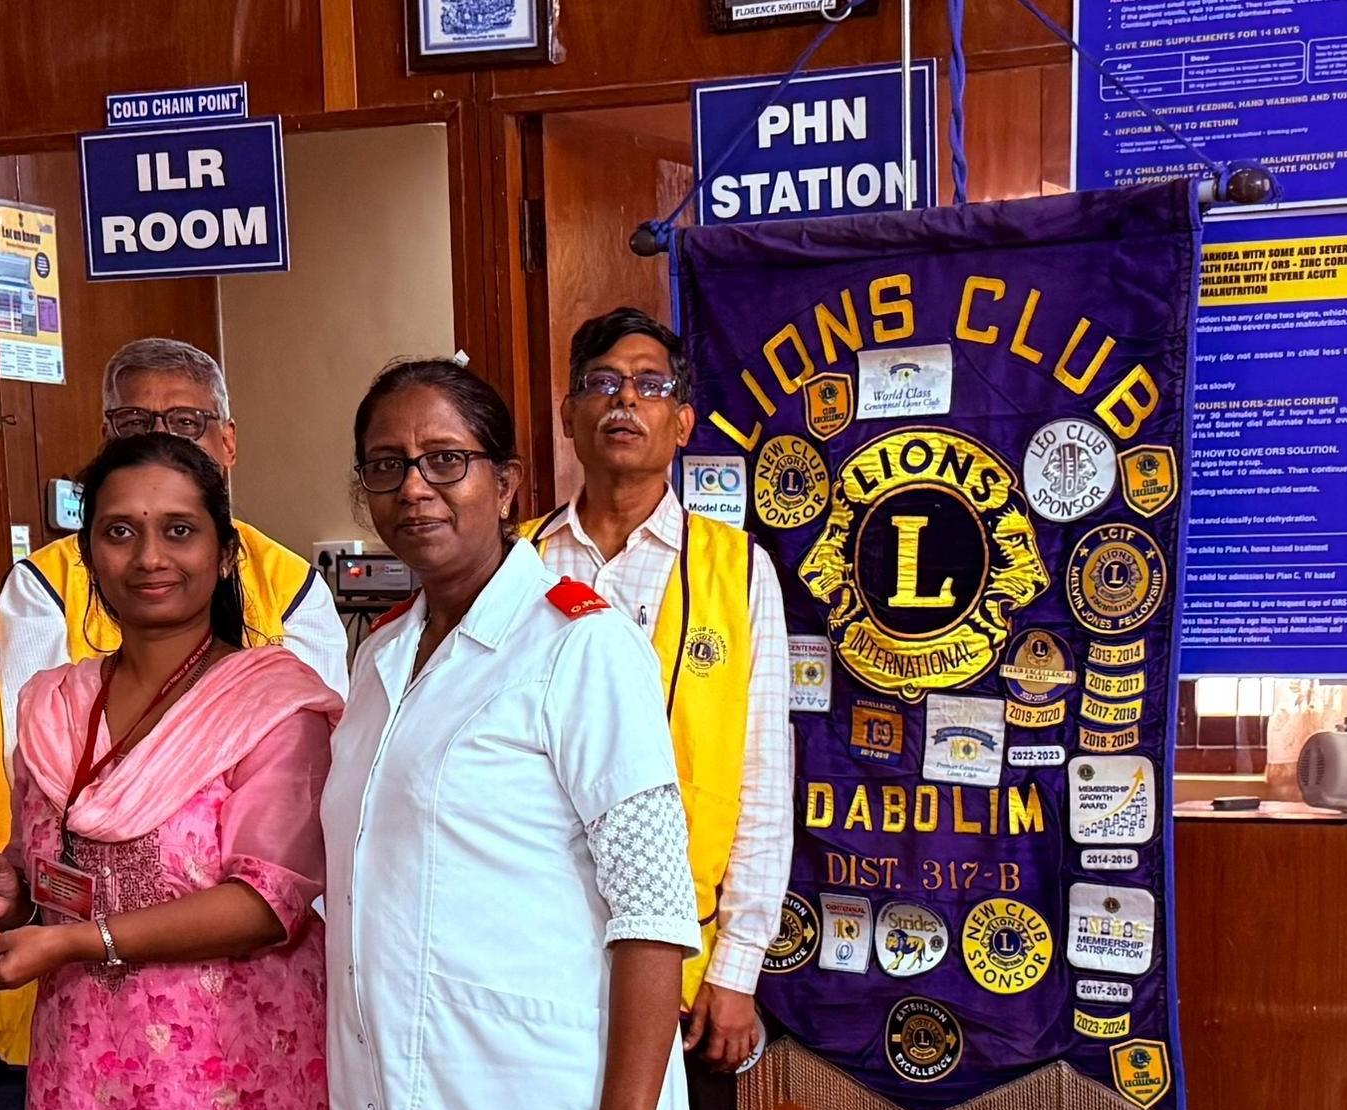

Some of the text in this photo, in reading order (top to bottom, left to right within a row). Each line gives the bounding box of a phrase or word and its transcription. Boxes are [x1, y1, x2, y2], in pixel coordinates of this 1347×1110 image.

[735, 6, 776, 16] FLORENCE
[1115, 41, 1137, 51] GIVE
[1141, 38, 1162, 48] ZINC
[1166, 32, 1235, 46] SUPPLEMENTS
[1238, 30, 1257, 38] FOR
[1274, 26, 1299, 36] DAYS
[113, 92, 239, 118] COLD CHAIN POINT
[757, 97, 867, 149] PHN
[136, 148, 225, 192] ILR
[711, 160, 918, 220] STATION
[102, 206, 268, 254] ROOM
[1242, 250, 1265, 259] WITH
[1268, 247, 1294, 258] SOME
[1297, 246, 1316, 256] AND
[1224, 261, 1263, 272] FACILITY
[1272, 258, 1290, 269] ORS
[1300, 256, 1321, 268] ZINC
[1270, 269, 1337, 281] SEVERE ACUTE
[1200, 285, 1268, 297] MALNUTRITION
[709, 273, 1159, 452] LIONS CLUB
[873, 388, 931, 401] World Class
[1031, 424, 1106, 459] LEO CLUB
[758, 440, 826, 483] NEW CLUB
[851, 437, 1002, 506] LIONS
[689, 502, 741, 513] Model Club
[757, 489, 826, 525] SPONSOR
[1033, 485, 1106, 517] SPONSOR
[1099, 527, 1136, 541] LCIF
[888, 514, 956, 608] L
[1071, 566, 1084, 612] MELVIN
[1082, 609, 1112, 629] JONES
[1118, 568, 1162, 627] FELLOWSHIP
[849, 630, 978, 679] INTERNATIONAL
[1089, 644, 1140, 661] 2013-2014
[1089, 674, 1140, 692] 2016-2017
[1009, 706, 1060, 723] 2019-2020
[1085, 701, 1137, 720] 2017-2018
[1083, 731, 1135, 748] 2018-2019
[1012, 751, 1060, 760] 2022-2023
[1078, 785, 1129, 793] MEMBERSHIP
[1079, 793, 1112, 801] GROWTH
[805, 782, 1044, 835] DABOLIM
[1079, 802, 1107, 810] AWARD
[1086, 855, 1133, 864] 2014-2015
[826, 852, 1021, 892] DIST. 317-B
[888, 912, 938, 933] Strides
[966, 903, 1047, 942] NEW CLUB
[1075, 944, 1143, 959] SATISFACTION
[1077, 935, 1144, 949] MEMBERSHIP
[968, 950, 1047, 988] SPONSOR
[1081, 985, 1128, 996] 2017-2018
[896, 1003, 947, 1023] EXTENSION
[1076, 1015, 1126, 1033] 2023-2024
[895, 1053, 952, 1076] EXCELLENCE
